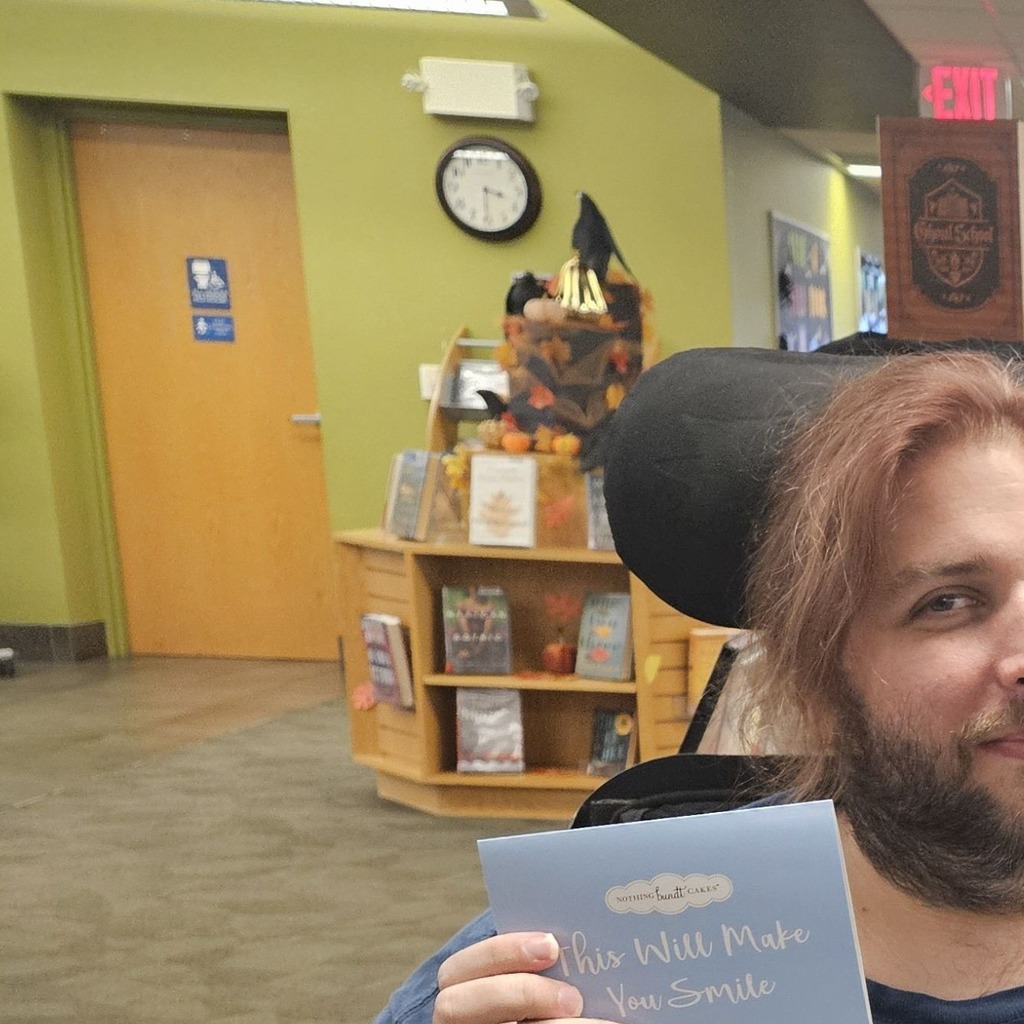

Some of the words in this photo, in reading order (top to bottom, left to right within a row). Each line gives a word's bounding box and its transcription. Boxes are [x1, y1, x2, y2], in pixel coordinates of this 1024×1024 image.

[931, 66, 997, 120] EXIT
[616, 892, 655, 904] NOTHING
[655, 886, 688, 902] bundt
[559, 931, 625, 977] This
[633, 931, 713, 966] Will
[721, 920, 810, 957] Make
[606, 983, 663, 1018] You
[667, 973, 776, 1009] Smile
